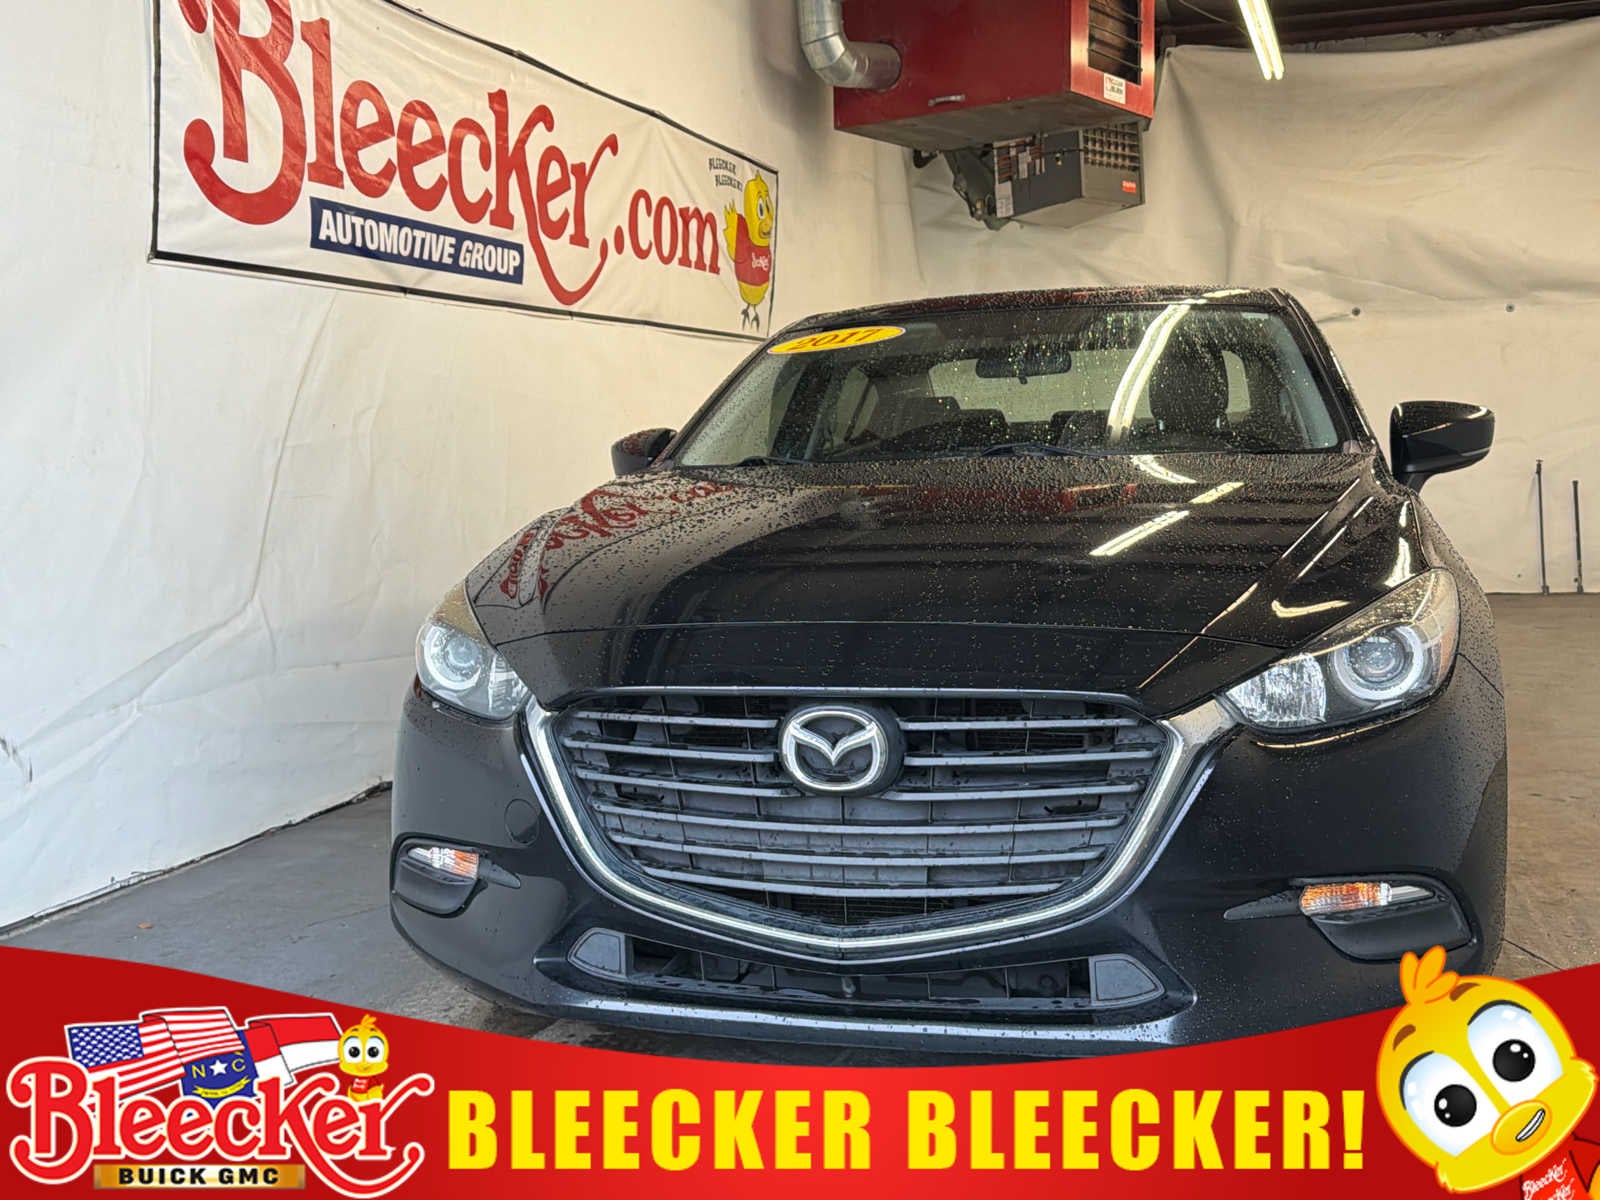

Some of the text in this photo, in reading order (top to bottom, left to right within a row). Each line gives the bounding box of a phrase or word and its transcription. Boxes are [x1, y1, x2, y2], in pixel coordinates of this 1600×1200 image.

[319, 208, 521, 276] AUTOMOTIVE GROUP
[787, 328, 883, 350] 2017
